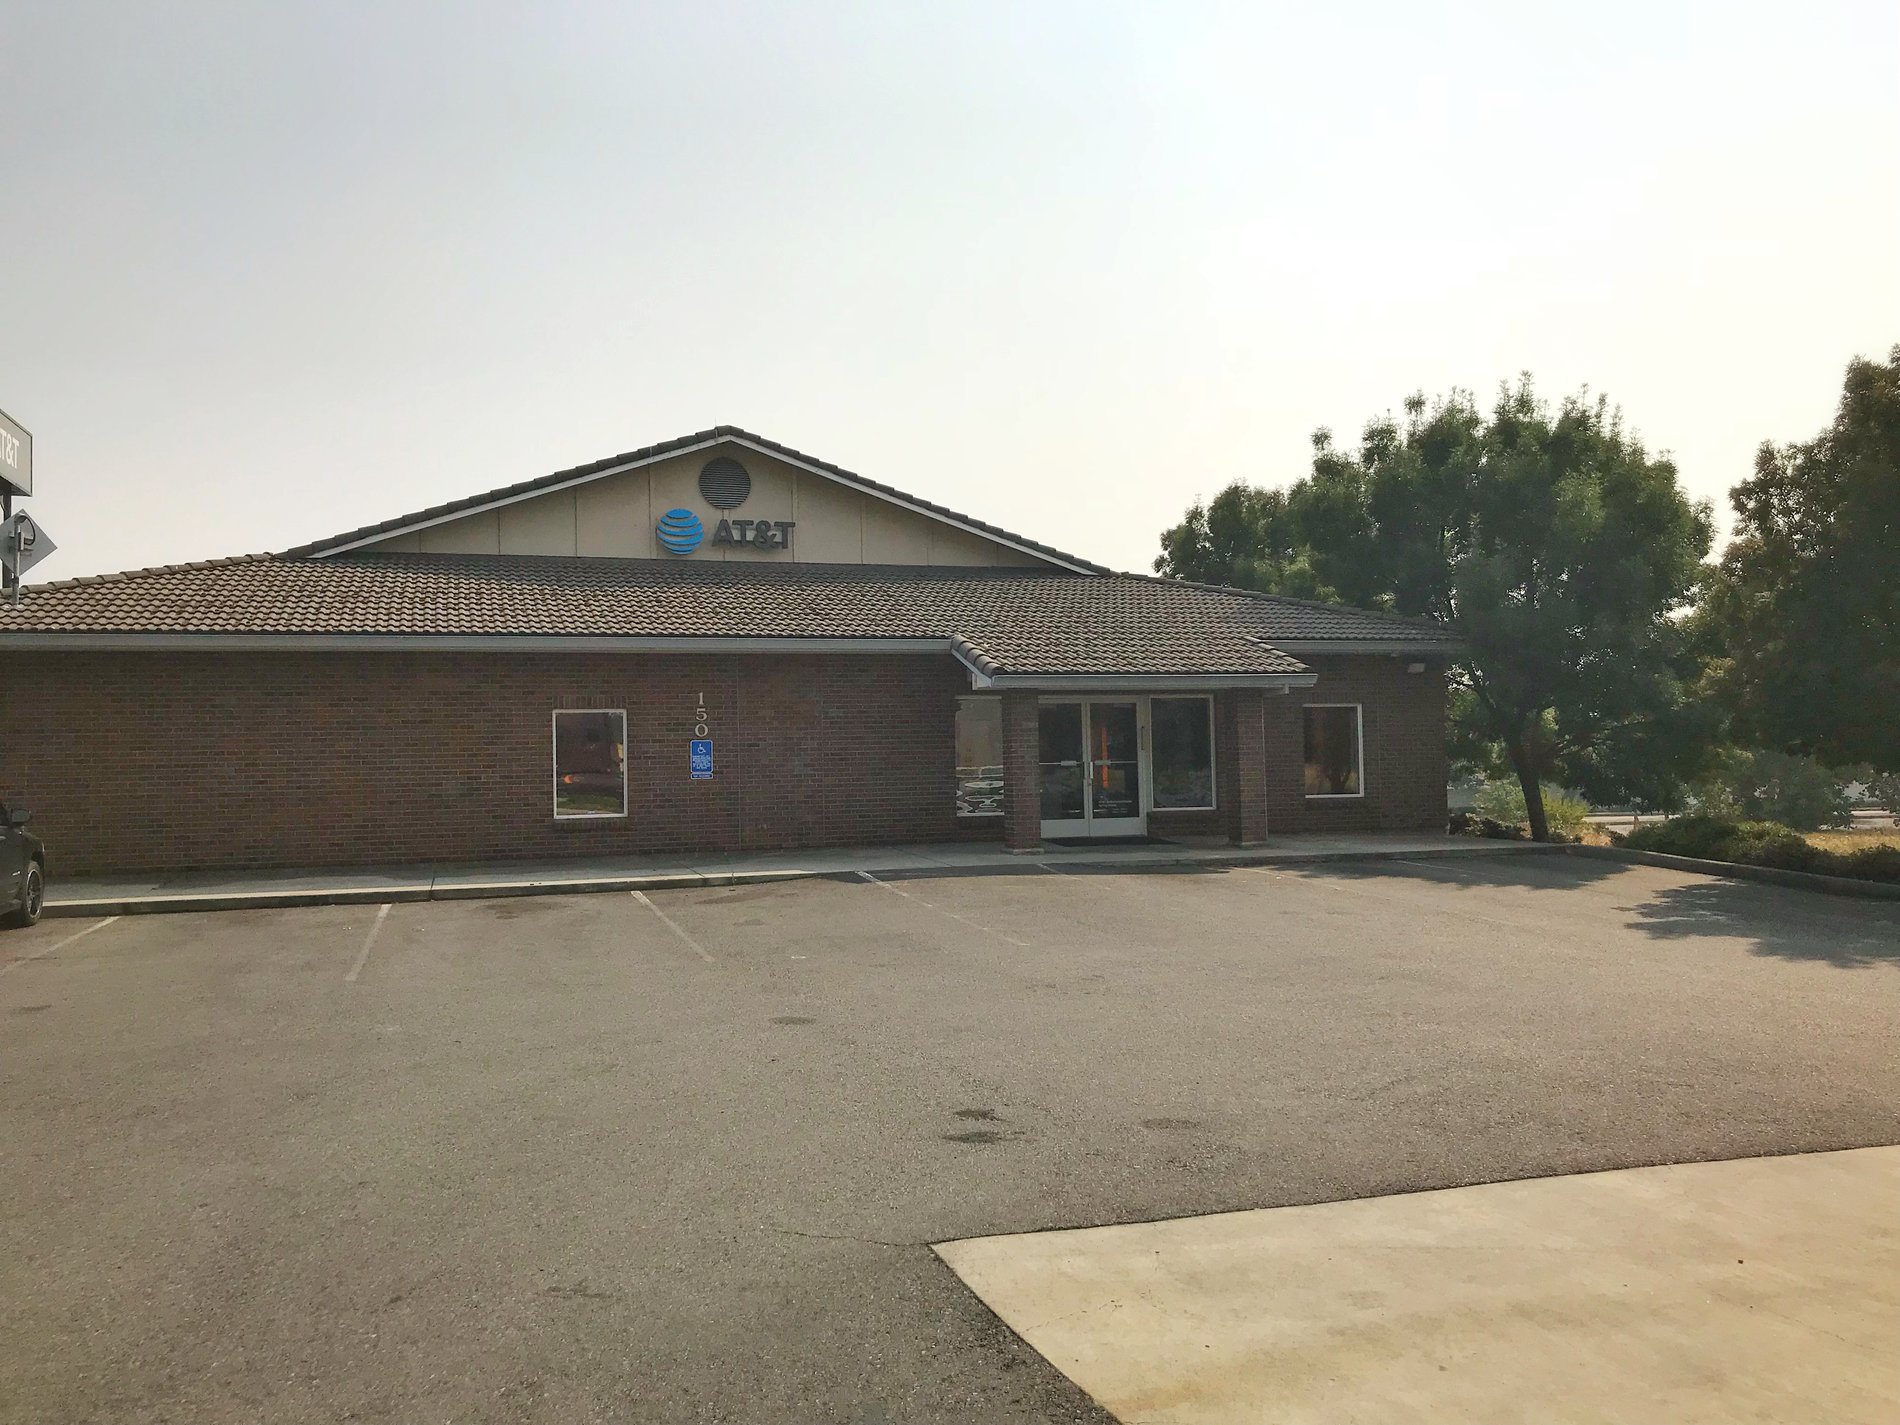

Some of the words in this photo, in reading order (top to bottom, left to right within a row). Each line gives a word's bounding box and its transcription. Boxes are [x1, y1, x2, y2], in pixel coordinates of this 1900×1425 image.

[0, 427, 20, 469] T&T
[712, 518, 796, 549] AT&T
[694, 692, 709, 737] 150
